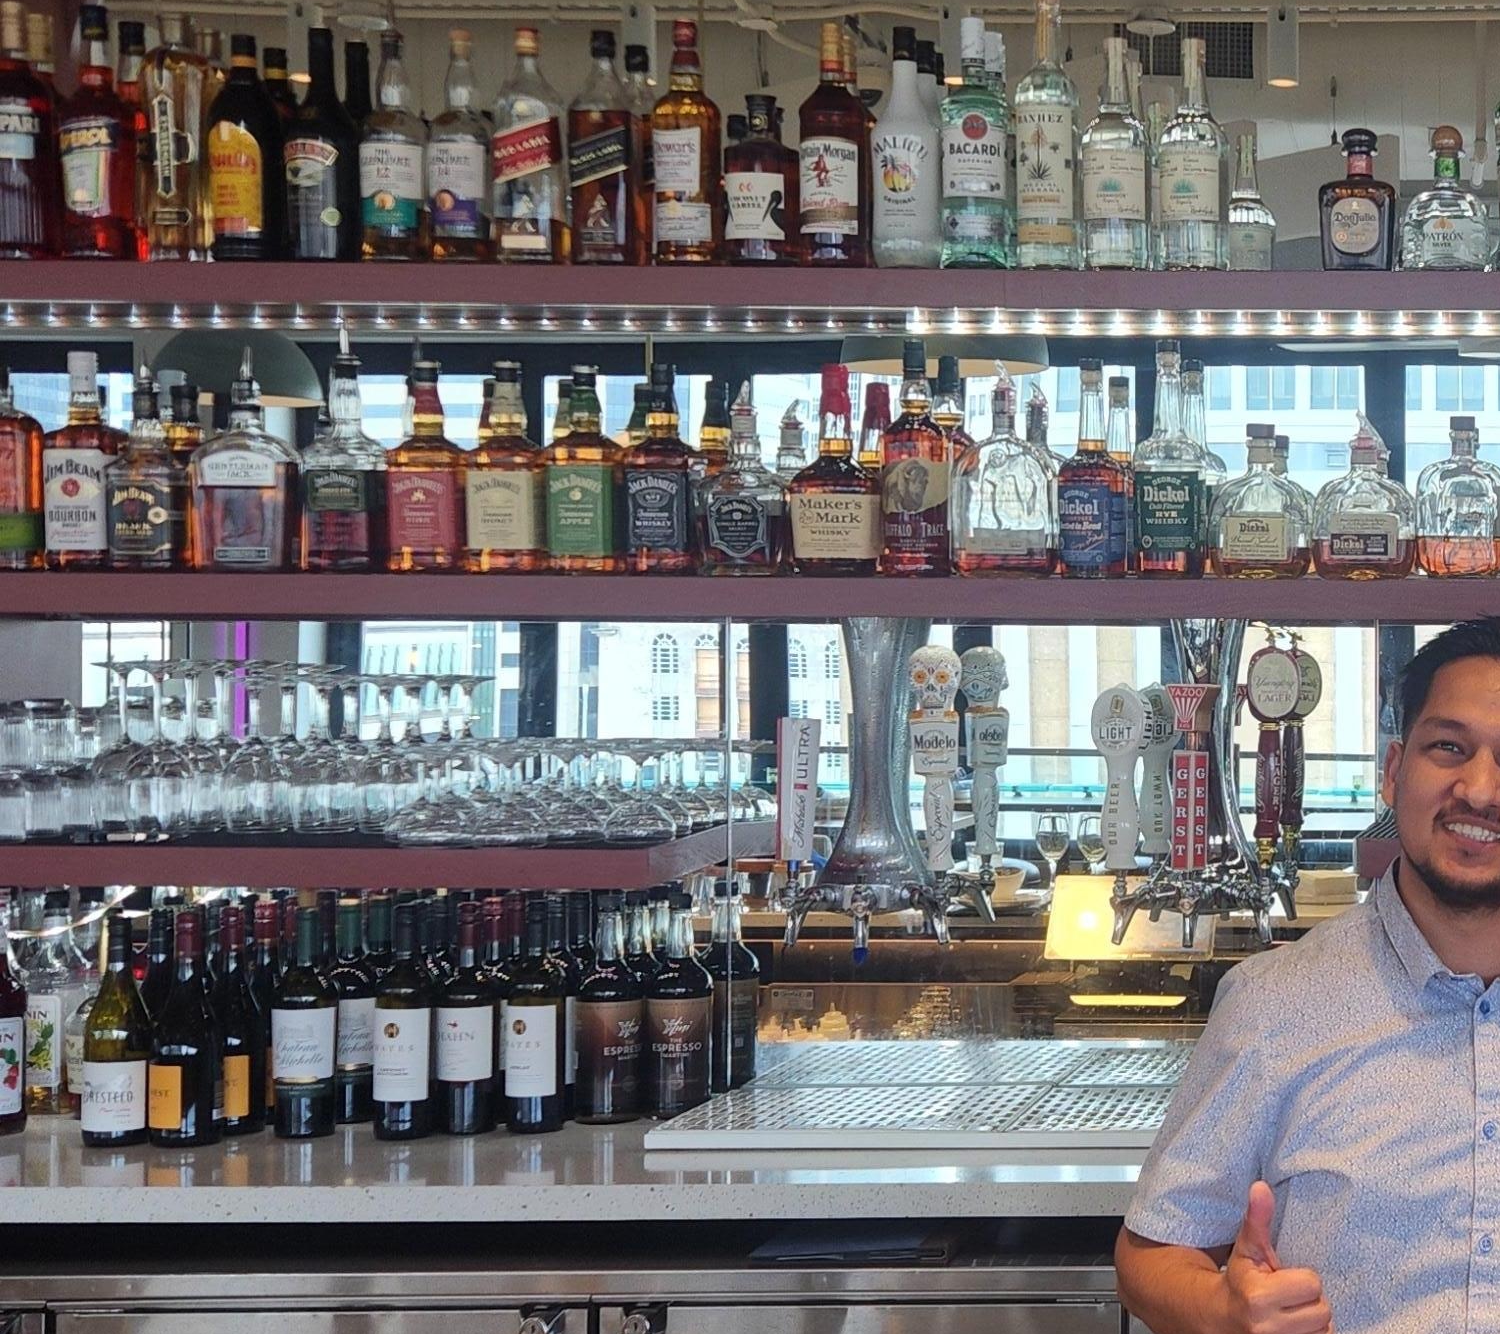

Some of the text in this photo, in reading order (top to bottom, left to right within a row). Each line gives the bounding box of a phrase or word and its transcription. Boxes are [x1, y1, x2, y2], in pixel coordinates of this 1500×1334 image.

[823, 143, 856, 163] Morgan
[873, 136, 928, 162] MALIBU
[65, 459, 100, 482] BEAM
[628, 478, 647, 494] JACK
[1143, 485, 1189, 502] Dickel
[800, 498, 862, 509] Maker's
[1059, 499, 1099, 515] Dickel
[816, 512, 862, 524] Mark
[921, 522, 944, 537] TRACE
[1239, 522, 1270, 533] Dickel
[1333, 540, 1364, 549] Dickel
[1170, 687, 1202, 697] YAZOO
[1258, 694, 1291, 702] LAGER
[1099, 727, 1133, 739] LIGHT
[914, 735, 956, 749] Modelo
[798, 726, 811, 779] ULTRA
[1176, 768, 1188, 856] GERST
[1194, 767, 1206, 855] GERST
[1108, 822, 1118, 845] OUR
[652, 1042, 702, 1052] ESPRESSO
